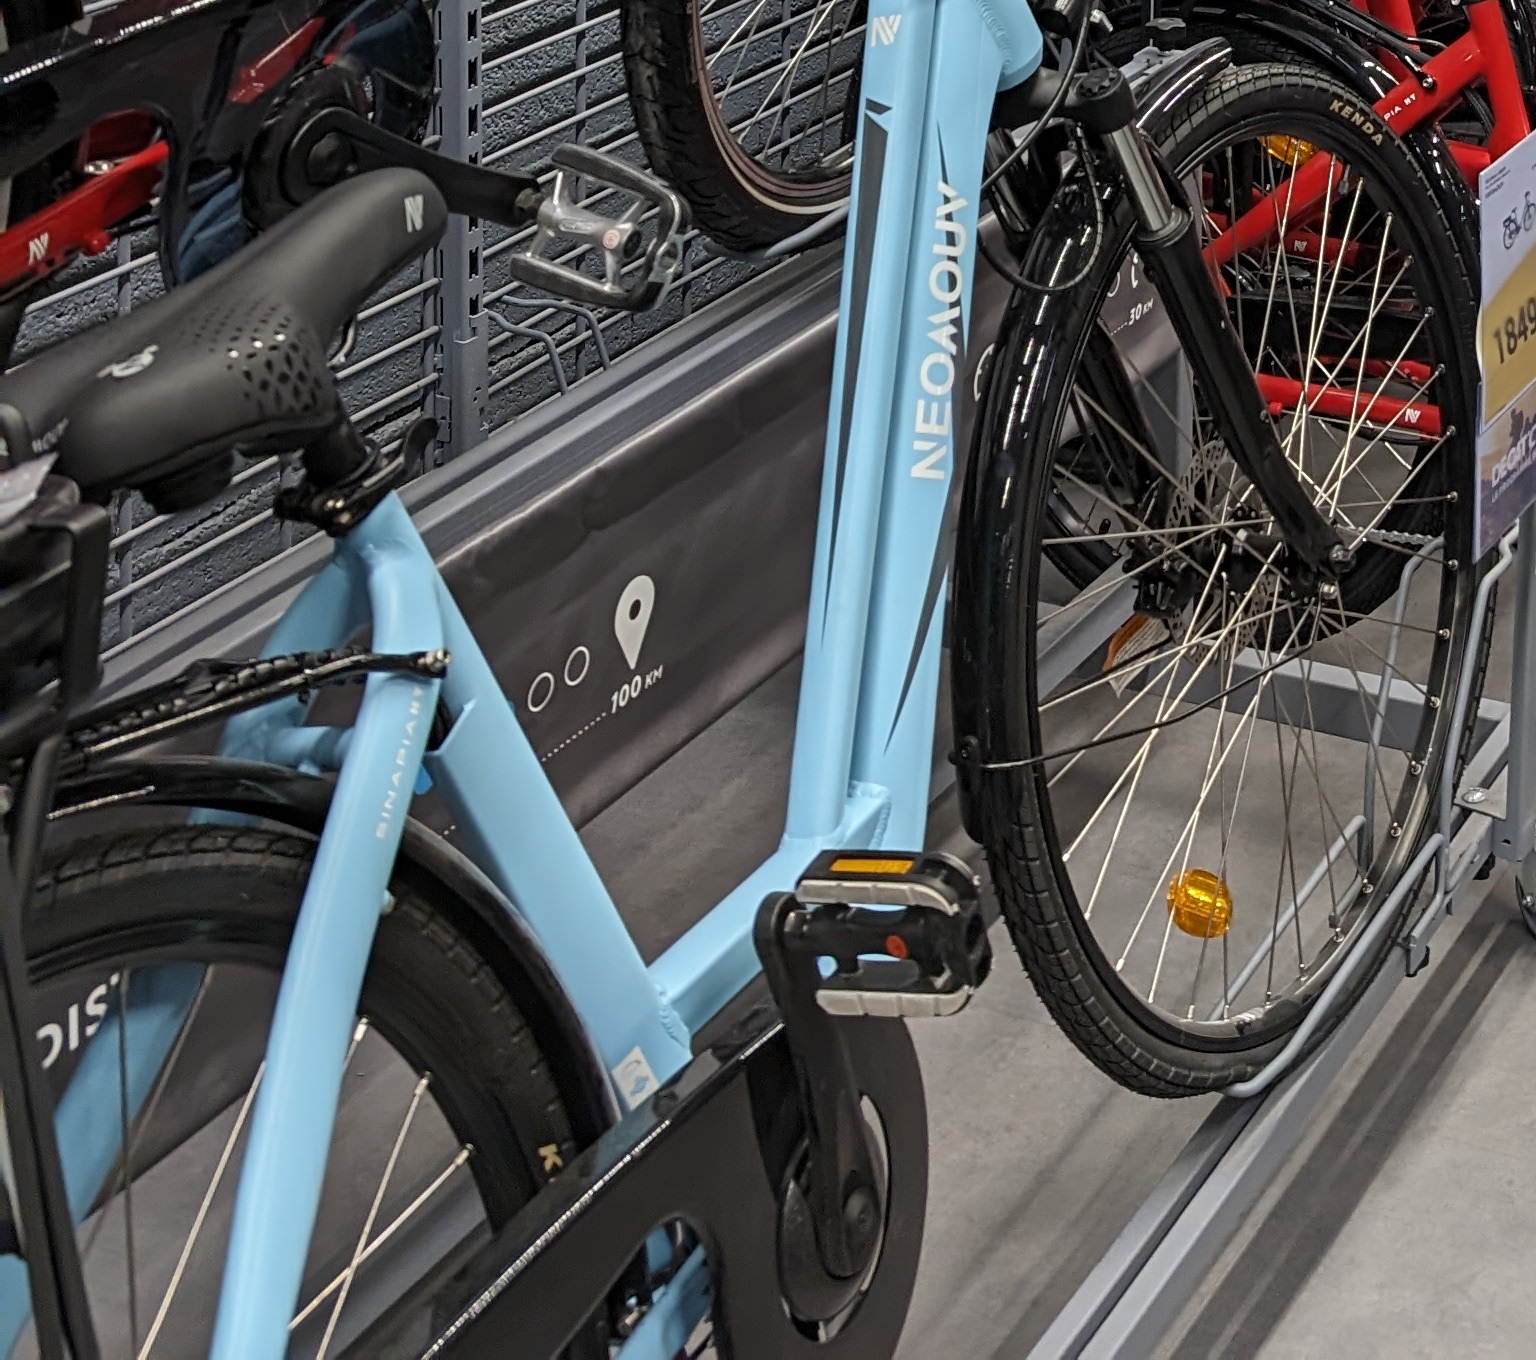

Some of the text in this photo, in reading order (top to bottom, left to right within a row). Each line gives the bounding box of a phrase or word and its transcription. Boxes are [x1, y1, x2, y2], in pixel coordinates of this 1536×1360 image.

[1329, 98, 1384, 147] KENDA
[910, 180, 964, 481] NEOMOUV
[1128, 303, 1143, 326] 30
[611, 664, 664, 714] 100 KM
